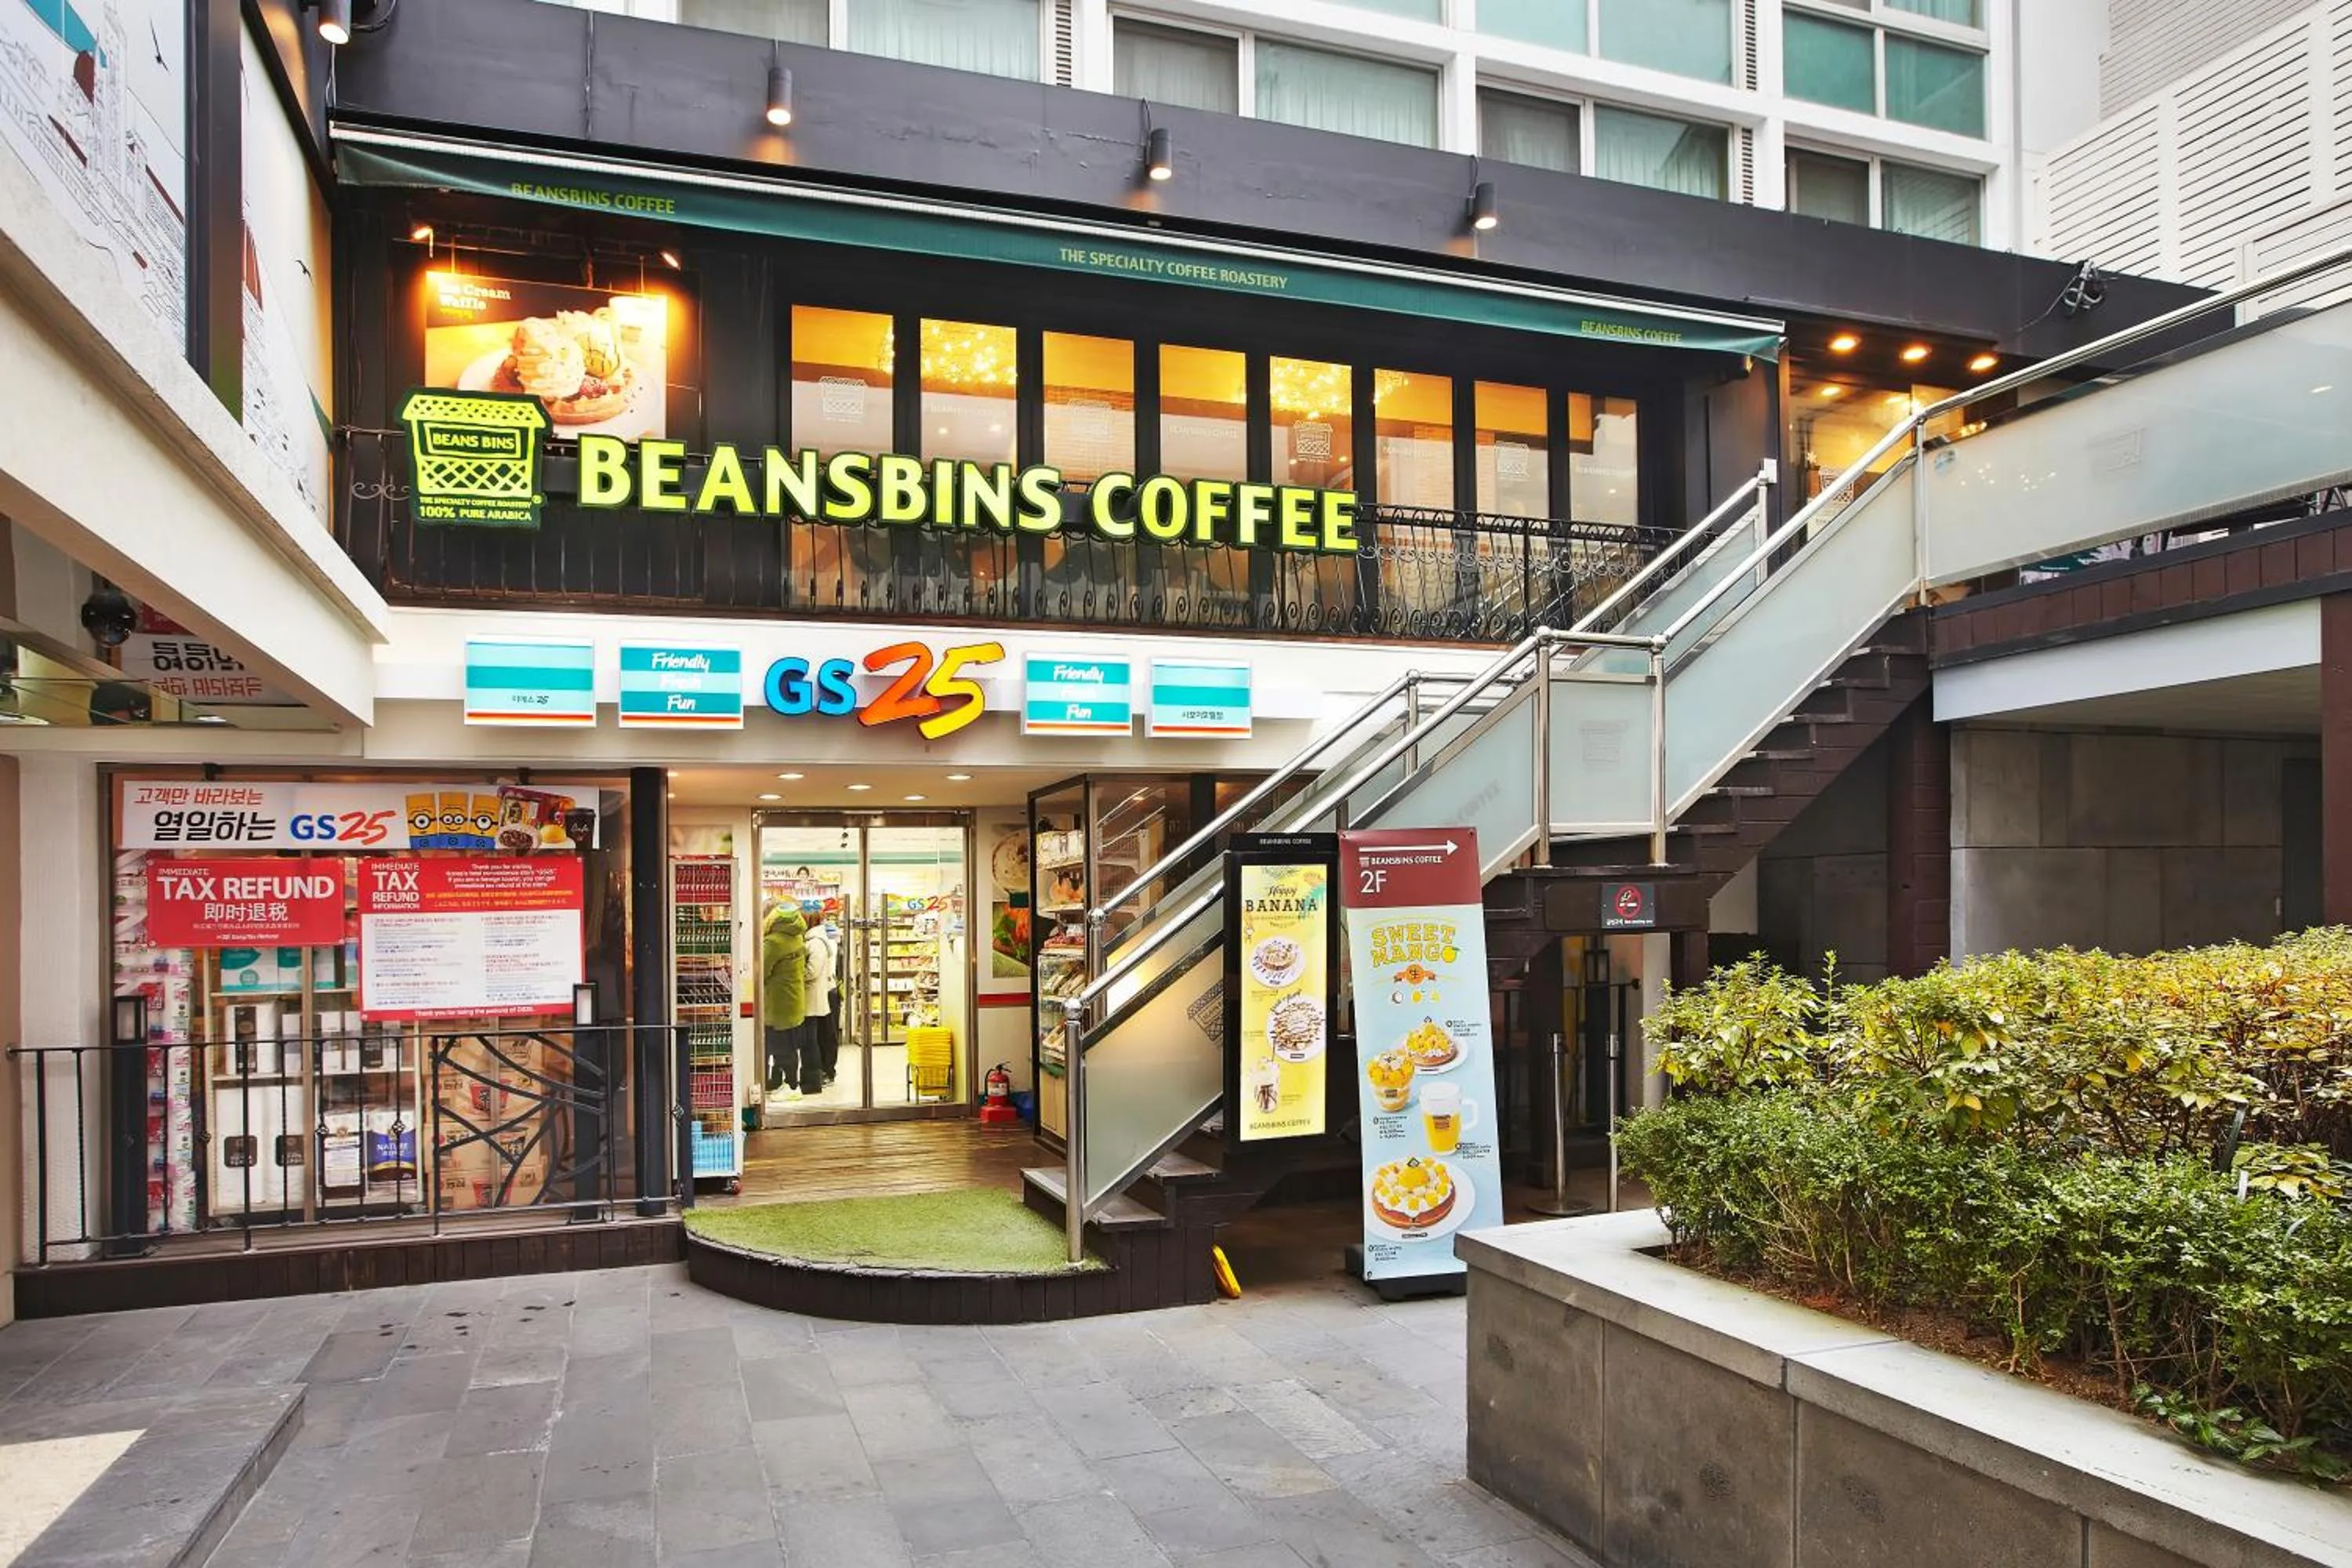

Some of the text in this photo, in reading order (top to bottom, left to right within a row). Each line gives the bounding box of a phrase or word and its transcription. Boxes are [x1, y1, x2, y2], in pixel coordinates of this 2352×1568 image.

[511, 183, 675, 214] BEANSBINS COFFEE
[1060, 248, 1287, 289] THE SPECIALTY COFFEE ROASTERY
[465, 283, 511, 300] Cream
[1581, 321, 1682, 344] BEANSBINS COFFEE
[432, 433, 515, 451] BEANS BINS
[577, 432, 1360, 552] BEANSBINS COFFEE
[419, 506, 532, 521] 100% PURE ARABICA
[652, 652, 710, 673] Friendly
[1054, 666, 1104, 684] Friendly
[764, 641, 1006, 740] GS25
[667, 695, 695, 711] Fun
[134, 788, 263, 805] 고객만 바라보는
[154, 810, 396, 846] 열일하는 GS25
[157, 877, 335, 900] TAX REFUND
[372, 872, 419, 891] TAX
[1359, 870, 1388, 893] 2F
[372, 892, 419, 902] REFUND
[1245, 898, 1319, 913] BANANA
[204, 902, 289, 922] 即时退税
[1371, 924, 1456, 946] SWEET
